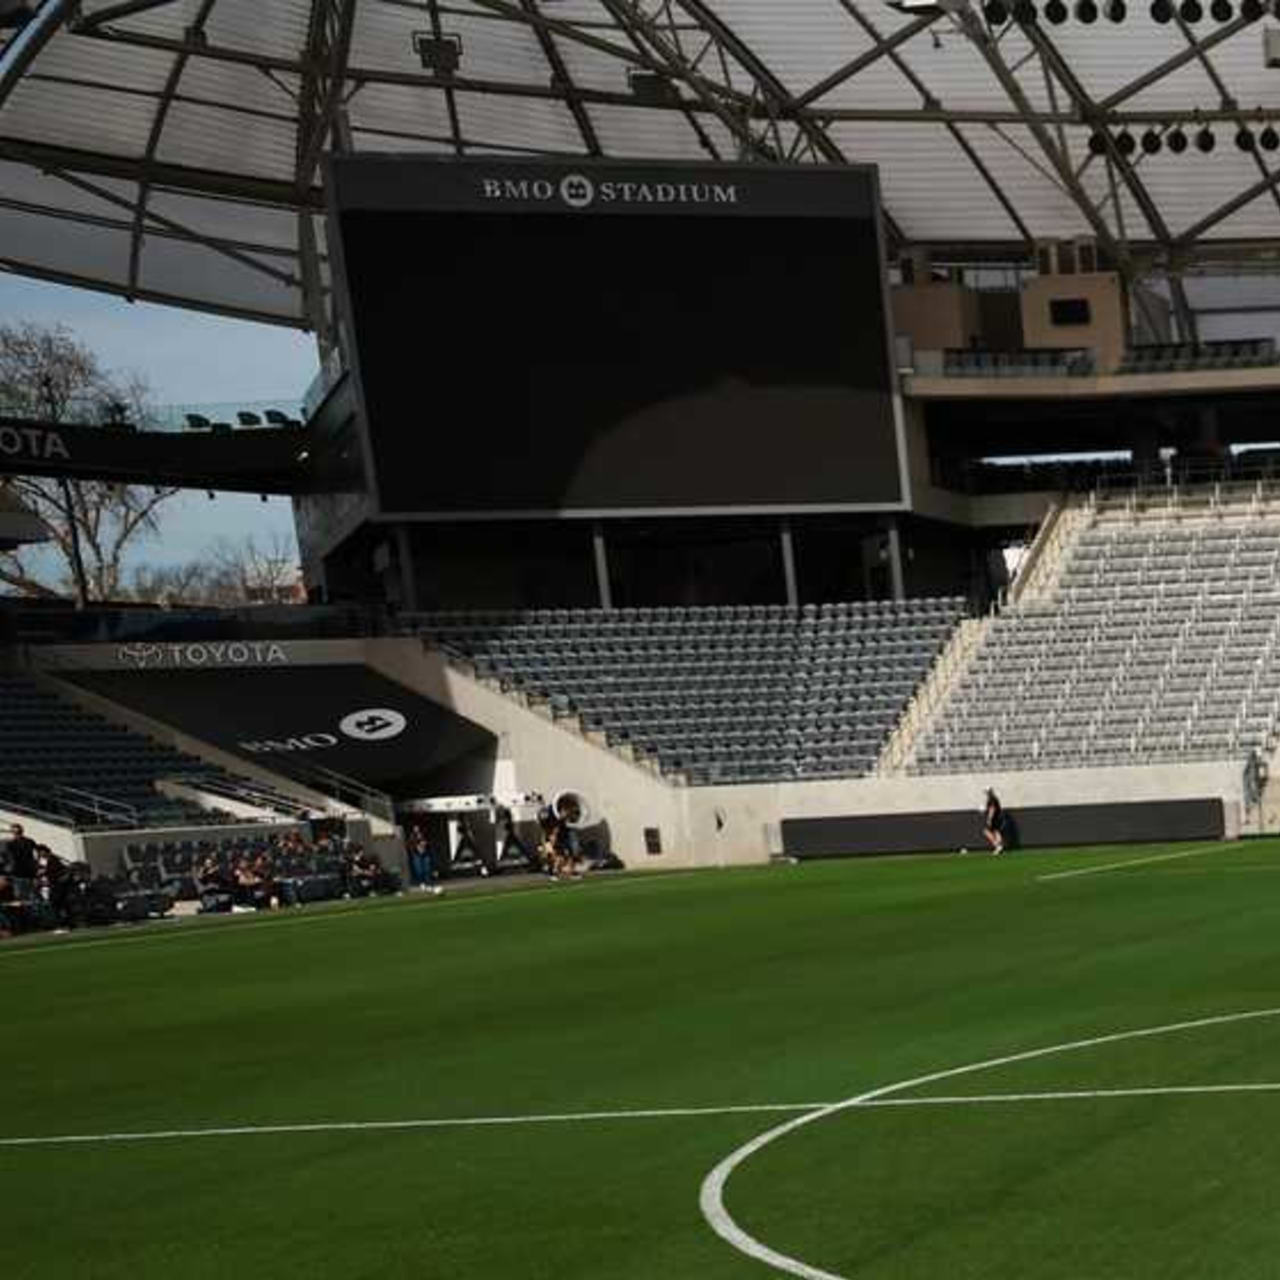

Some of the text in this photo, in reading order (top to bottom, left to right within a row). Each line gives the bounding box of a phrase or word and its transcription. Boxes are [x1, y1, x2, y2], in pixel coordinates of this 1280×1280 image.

[484, 180, 737, 202] BMO STADIUM
[172, 643, 290, 665] TOYOTA
